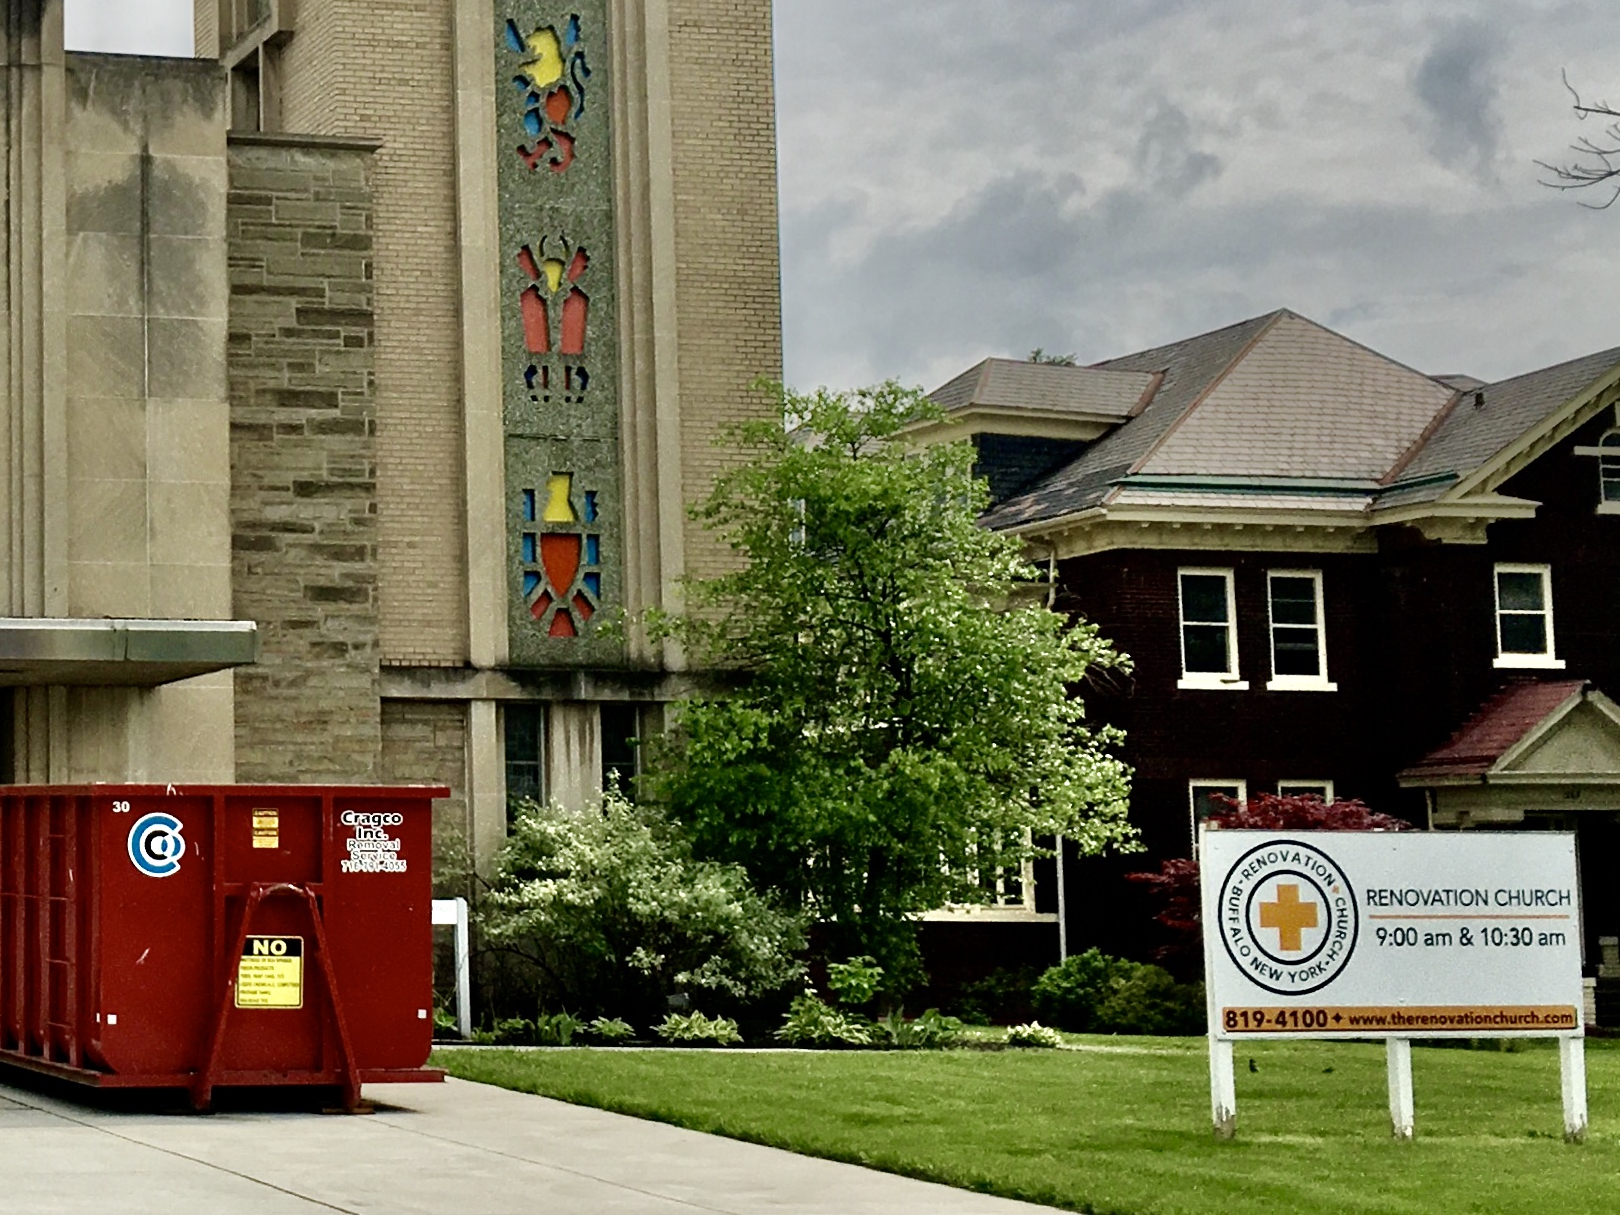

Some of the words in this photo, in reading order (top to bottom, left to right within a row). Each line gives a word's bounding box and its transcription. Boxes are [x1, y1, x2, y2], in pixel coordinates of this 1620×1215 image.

[112, 801, 131, 813] 30
[341, 810, 403, 827] Cragco
[356, 826, 389, 840] Inc.
[347, 838, 401, 851] Removal
[351, 850, 397, 861] Service
[1241, 850, 1336, 887] RENOVATION
[1328, 897, 1349, 961] CHURCH
[1366, 889, 1489, 907] RENOVATION
[1494, 889, 1571, 907] CHURCH
[1228, 885, 1252, 957] BUFFALO
[1250, 957, 1284, 982] NEW
[1288, 961, 1328, 983] YORK
[1376, 927, 1418, 947] 9:00
[1424, 932, 1453, 947] am
[1459, 927, 1475, 947] &
[1481, 927, 1533, 947] 10:30
[1538, 932, 1566, 947] am
[253, 939, 287, 956] NO
[1225, 1009, 1328, 1029] 819-4100
[1348, 1010, 1574, 1027] www.therenovationchurch.com
